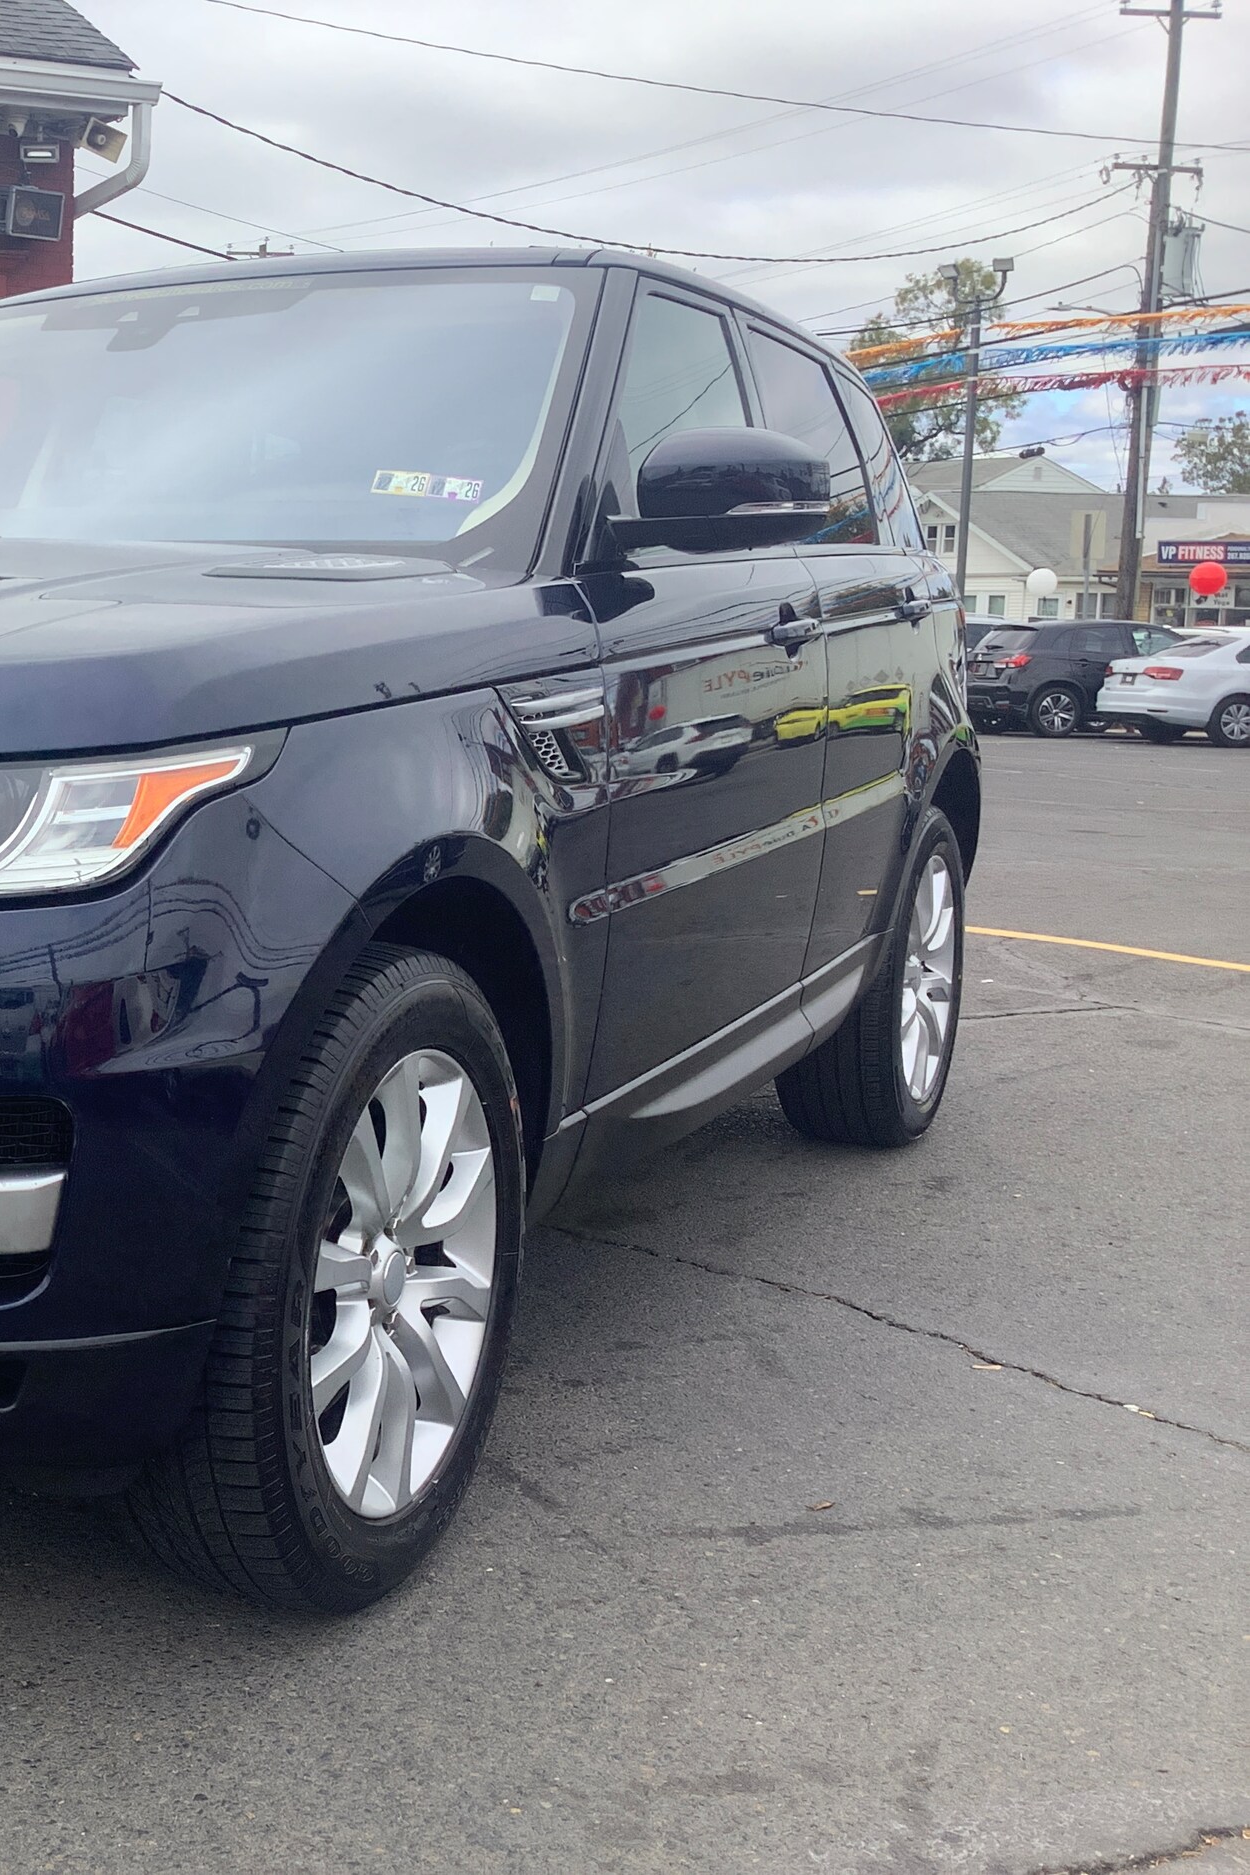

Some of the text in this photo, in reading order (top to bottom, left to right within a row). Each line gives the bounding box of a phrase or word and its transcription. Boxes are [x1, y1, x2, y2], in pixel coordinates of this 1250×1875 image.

[410, 475, 427, 492] 26
[464, 482, 482, 499] 26
[1161, 546, 1176, 560] VP
[1178, 546, 1225, 560] FITNESS
